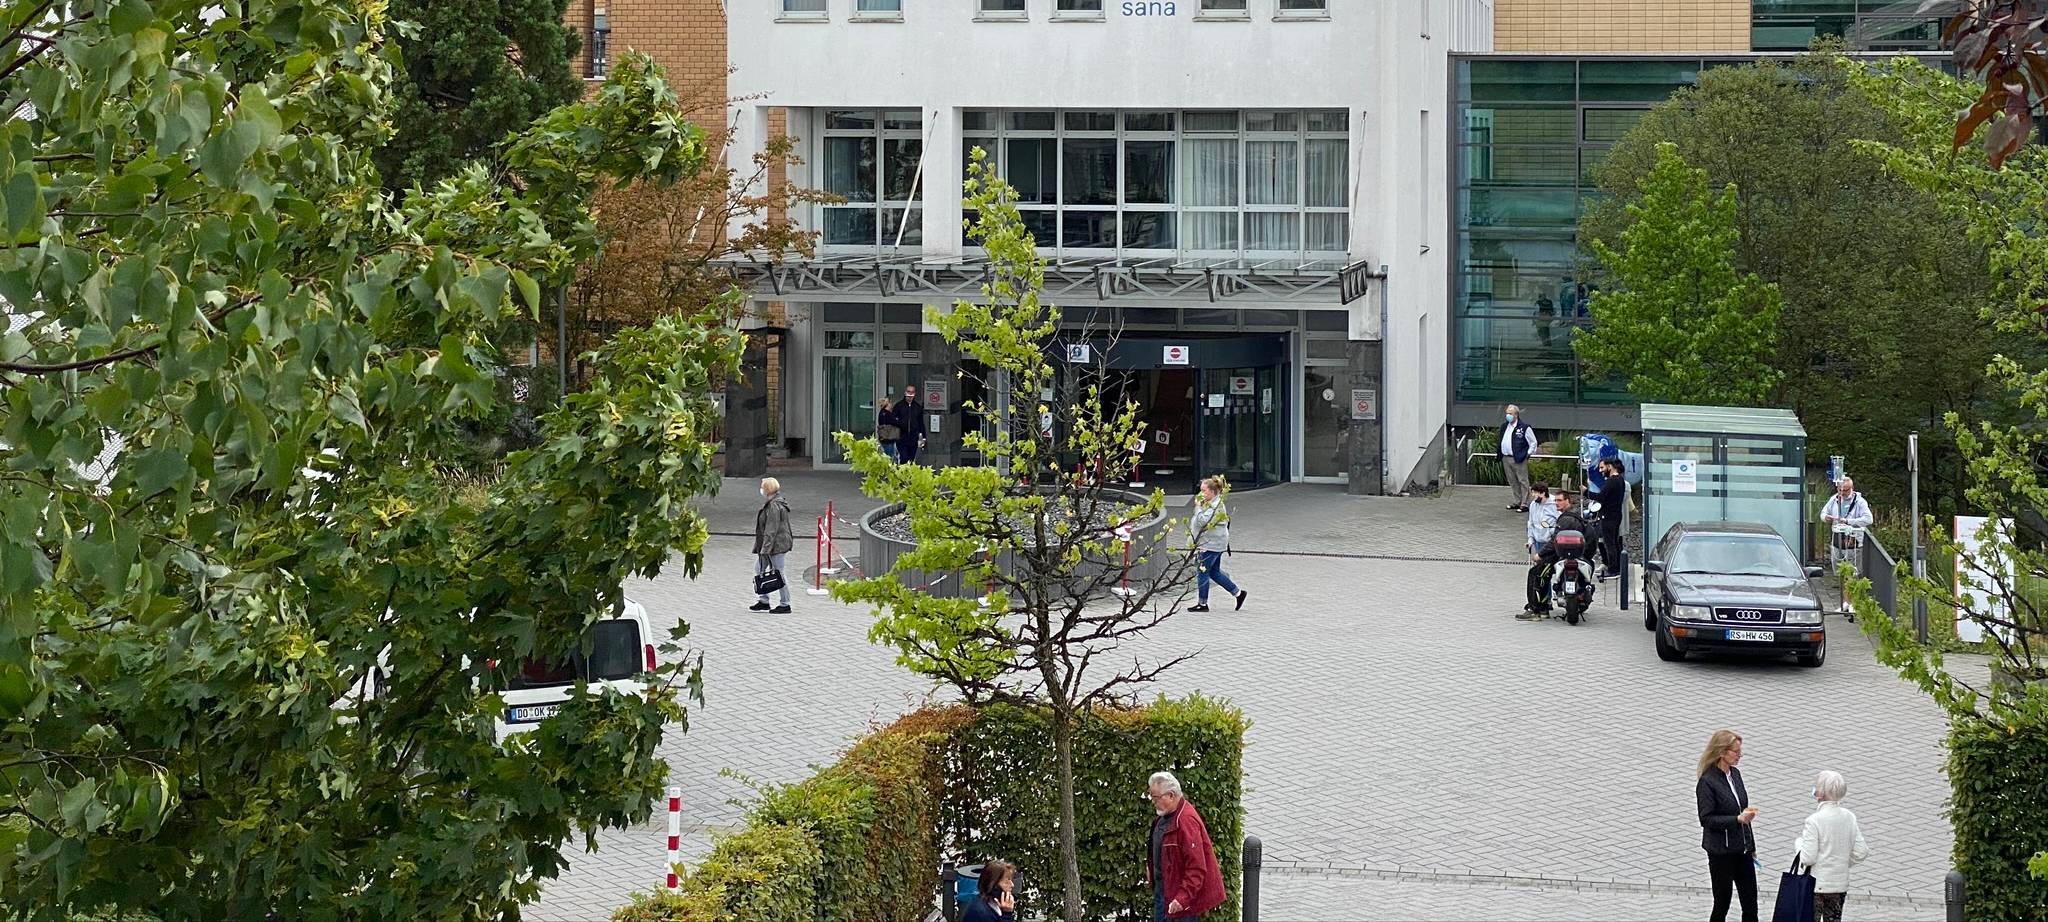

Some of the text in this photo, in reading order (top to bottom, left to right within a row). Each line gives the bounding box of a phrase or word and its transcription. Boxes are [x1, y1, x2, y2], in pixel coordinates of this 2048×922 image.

[1122, 1, 1176, 16] sana
[1730, 631, 1773, 640] RS HW 456
[517, 708, 528, 718] DO
[534, 707, 545, 717] OK
